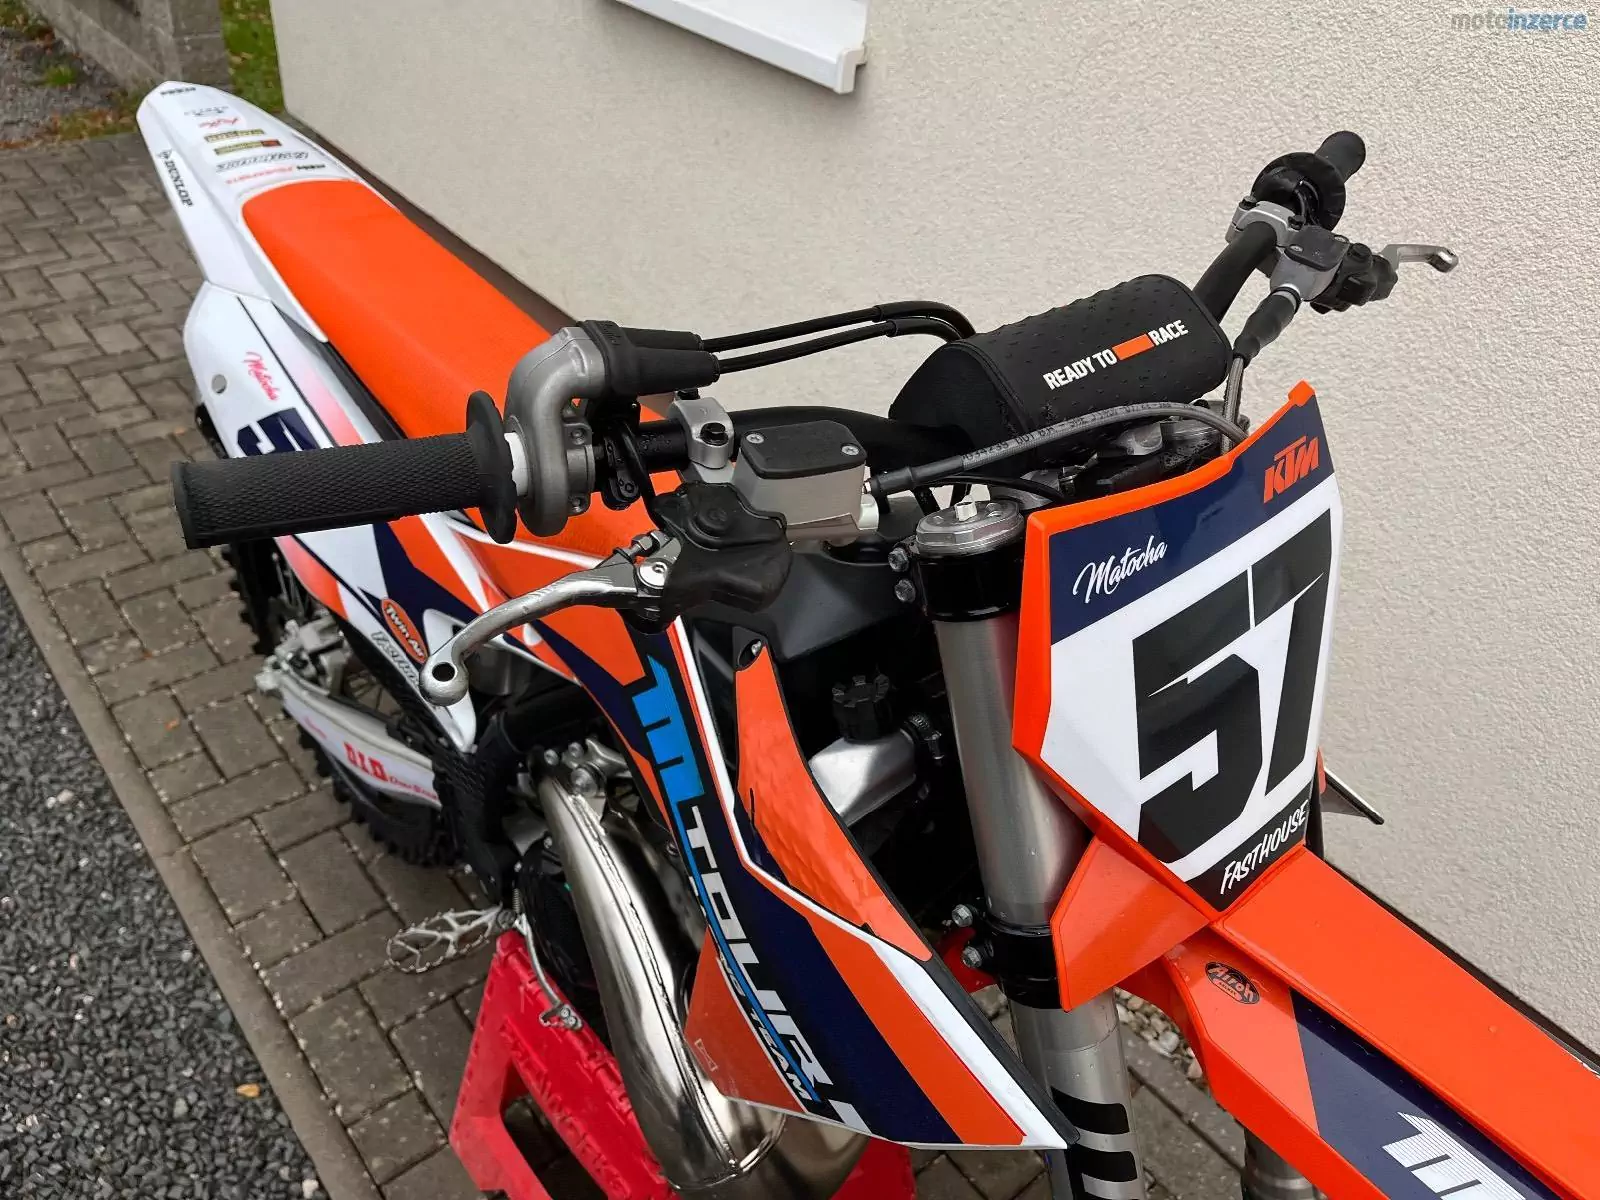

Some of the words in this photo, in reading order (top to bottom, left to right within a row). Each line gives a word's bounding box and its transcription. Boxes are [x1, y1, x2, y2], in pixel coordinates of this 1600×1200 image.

[164, 160, 194, 206] DUNLOP
[1042, 355, 1096, 391] READY
[1090, 348, 1118, 369] TO
[1148, 319, 1190, 348] RACE
[1263, 435, 1319, 505] KTM
[1072, 535, 1168, 604] Matocha
[1132, 508, 1333, 864] 57
[1220, 799, 1310, 895] FASTHOUSE
[1208, 963, 1255, 1003] Airoh
[750, 1008, 813, 1101] TEAM
